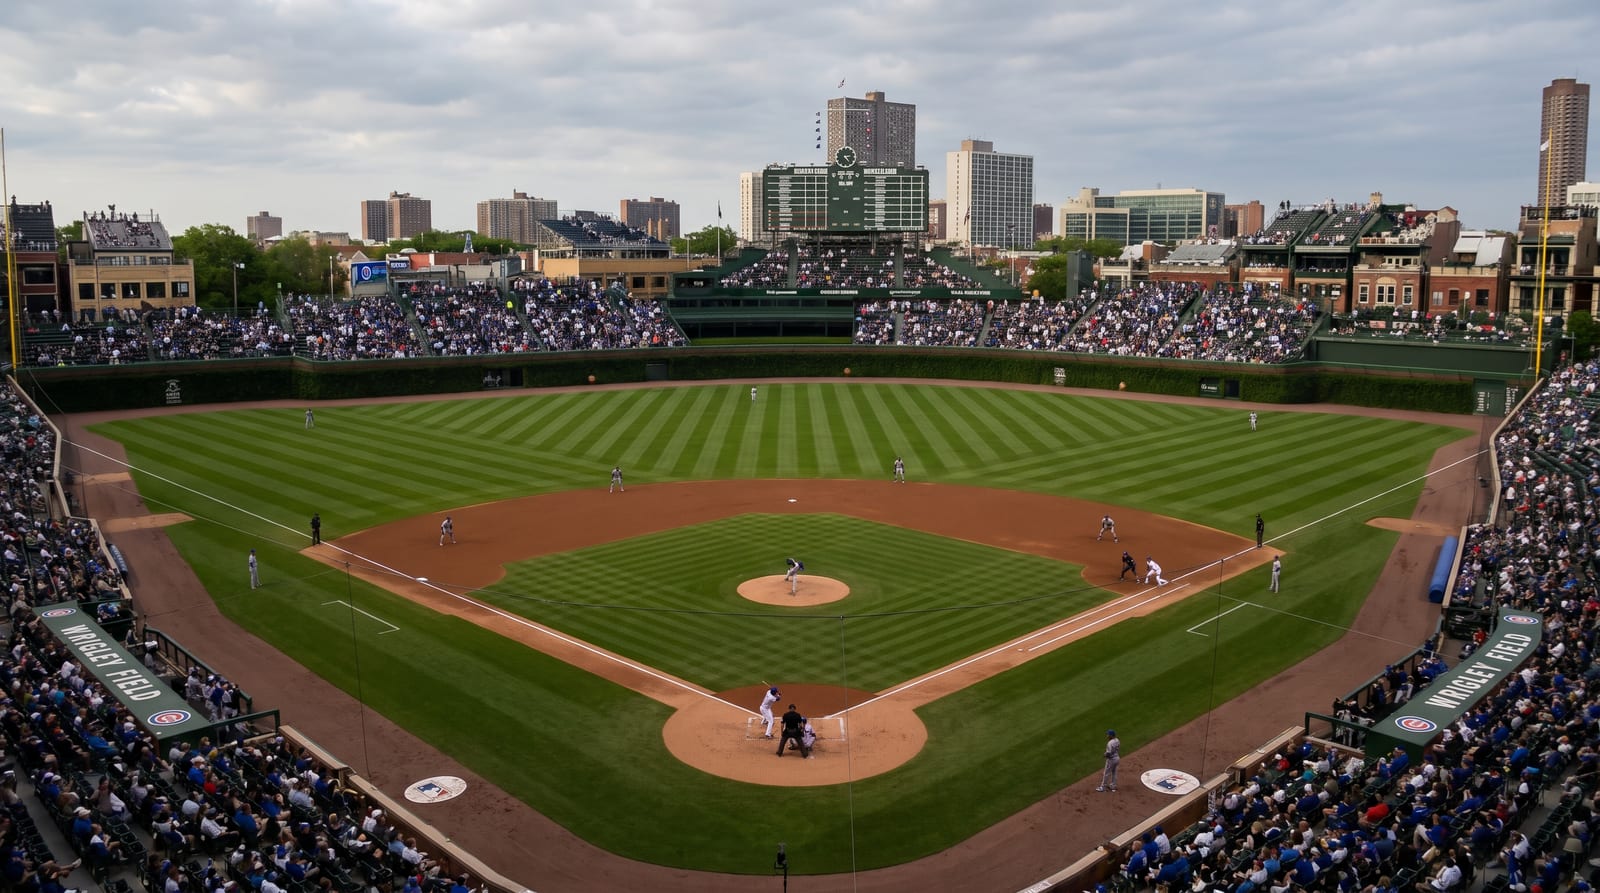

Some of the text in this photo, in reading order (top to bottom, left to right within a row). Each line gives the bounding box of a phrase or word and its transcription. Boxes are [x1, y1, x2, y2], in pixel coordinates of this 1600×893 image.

[61, 624, 161, 701] WRIGLEY FIELD
[1425, 633, 1532, 709] WRIGLEY FIELD
